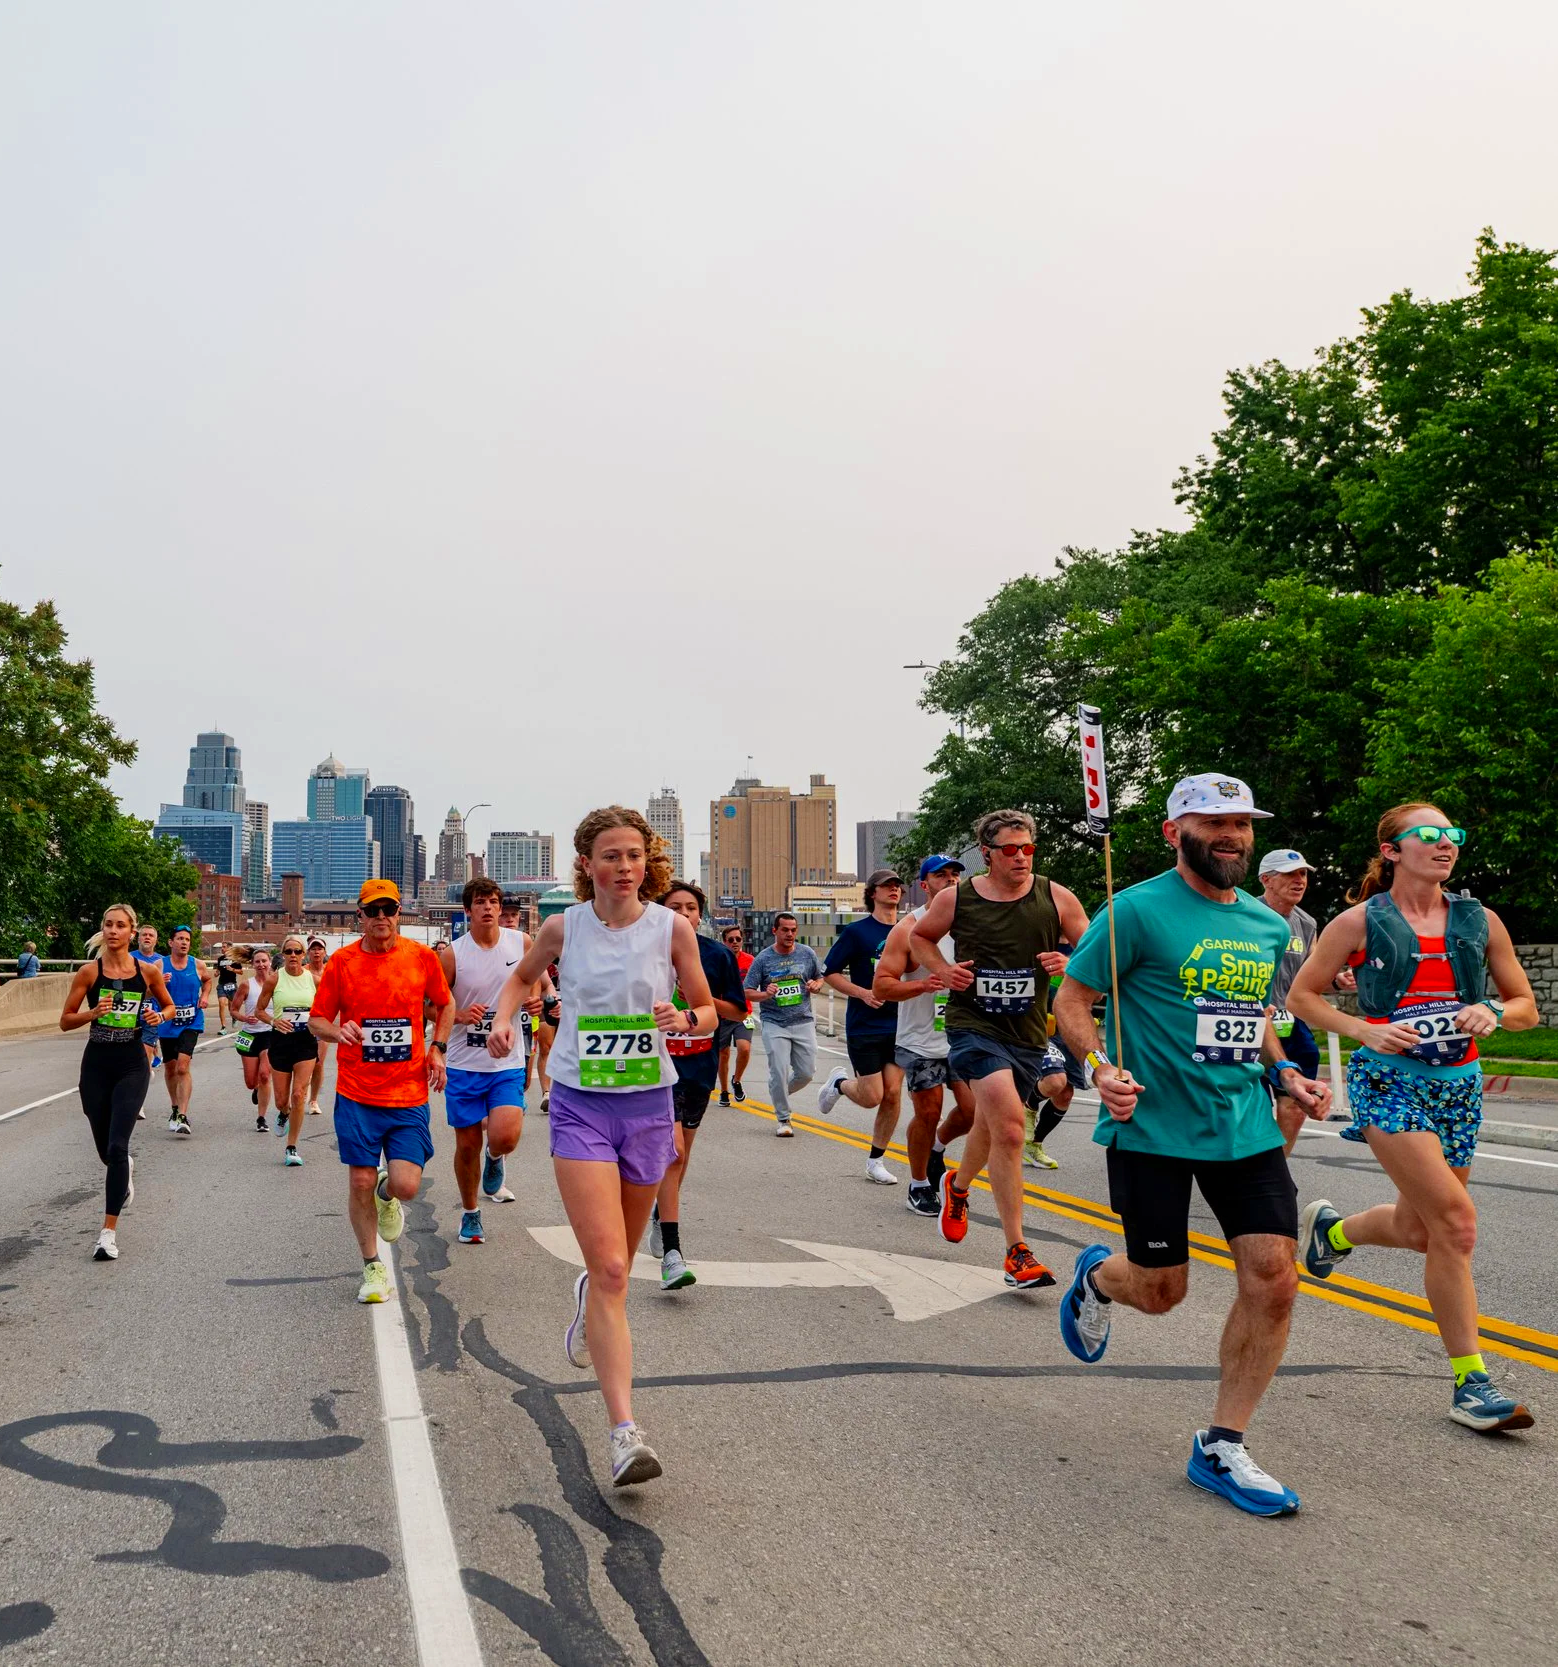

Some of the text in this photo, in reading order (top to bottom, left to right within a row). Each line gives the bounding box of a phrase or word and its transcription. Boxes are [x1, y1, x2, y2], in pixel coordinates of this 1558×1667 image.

[1202, 938, 1260, 952] GARMIN
[982, 980, 1029, 995] 1457
[1202, 968, 1271, 1000] Pacing
[777, 986, 800, 996] 2051
[1225, 990, 1257, 1001] Team
[1205, 1000, 1237, 1008] HOSPITAL
[1393, 1005, 1428, 1016] HOSPITAL
[1421, 1006, 1452, 1014] MARATHON
[176, 1009, 191, 1017] 614
[1214, 1020, 1258, 1044] 823
[1403, 1016, 1462, 1038] 02
[371, 1030, 404, 1043] 632
[586, 1033, 653, 1055] 2778
